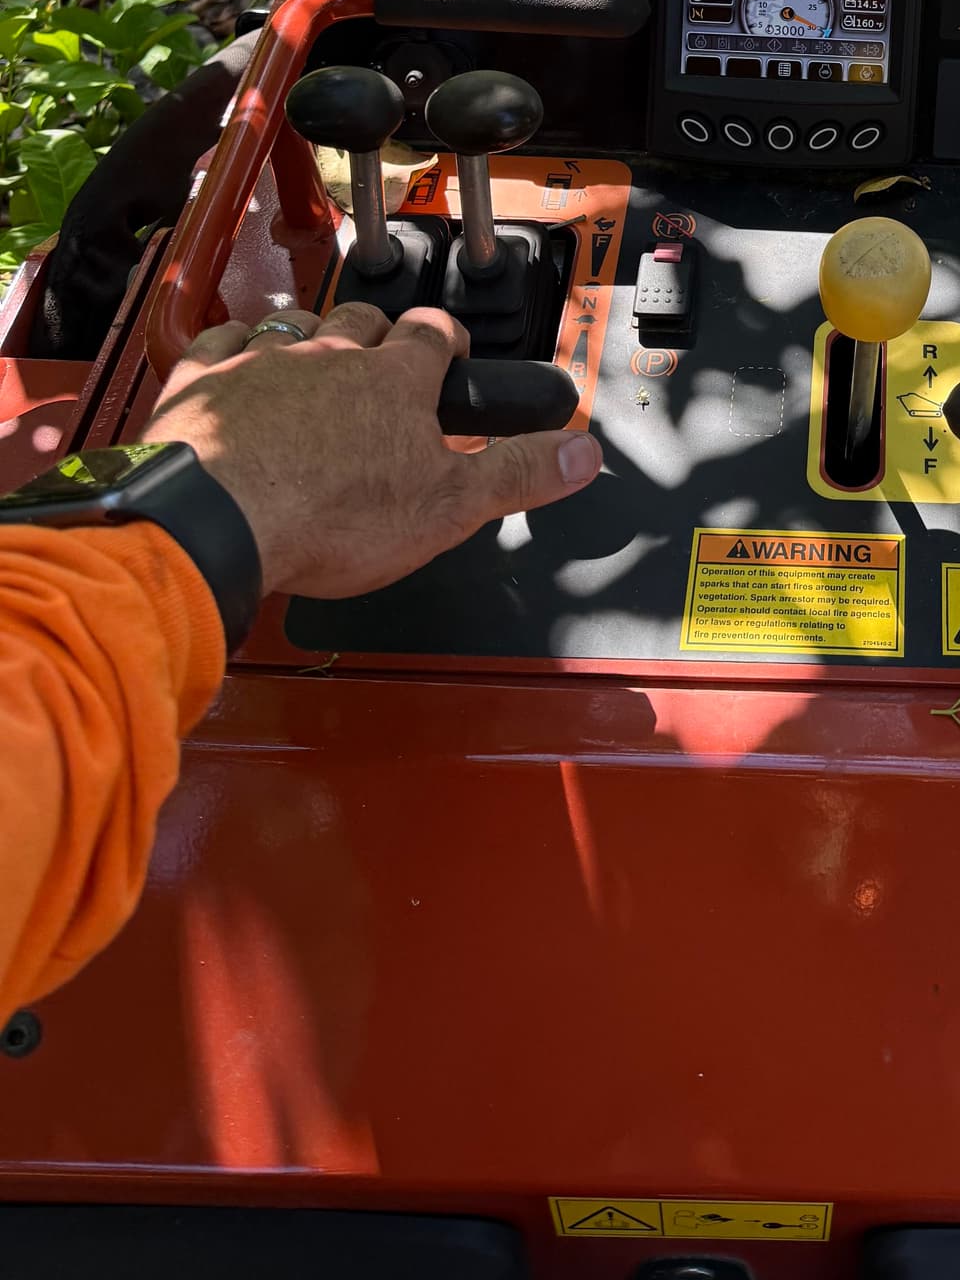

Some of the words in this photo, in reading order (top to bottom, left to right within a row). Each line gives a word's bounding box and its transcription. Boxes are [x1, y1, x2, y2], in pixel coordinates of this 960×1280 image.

[758, 1, 768, 9] 10
[857, 0, 878, 9] 14.5
[856, 18, 874, 28] 160
[774, 25, 805, 36] 3000
[595, 234, 607, 248] F
[582, 296, 597, 309] N
[923, 344, 938, 359] R
[572, 361, 584, 376] R
[924, 458, 938, 474] F
[751, 541, 872, 563] WARNING
[701, 567, 745, 578] Operation
[747, 568, 757, 576] of
[759, 569, 775, 577] this
[777, 570, 825, 580] equipment
[827, 572, 846, 581] may
[848, 572, 876, 580] create
[700, 580, 730, 590] sparks
[732, 580, 750, 589] that
[770, 582, 791, 591] start
[793, 582, 813, 591] fires
[815, 583, 847, 592] around
[849, 584, 864, 594] dry
[698, 591, 748, 603] vegetation.
[750, 593, 777, 604] Spark
[779, 595, 815, 604] arrestor
[817, 597, 836, 606] may
[838, 596, 850, 605] be
[697, 604, 738, 615] Operator
[739, 605, 770, 615] should
[773, 607, 806, 616] contact
[809, 608, 831, 617] local
[833, 609, 848, 618] fire
[850, 609, 891, 620] agencies
[695, 617, 710, 625] for
[711, 617, 732, 626] laws
[745, 619, 797, 630] regulations
[799, 620, 834, 631] relating
[836, 621, 846, 630] to
[694, 631, 709, 639] fire
[711, 631, 760, 642] prevention
[762, 632, 826, 643] requirements.
